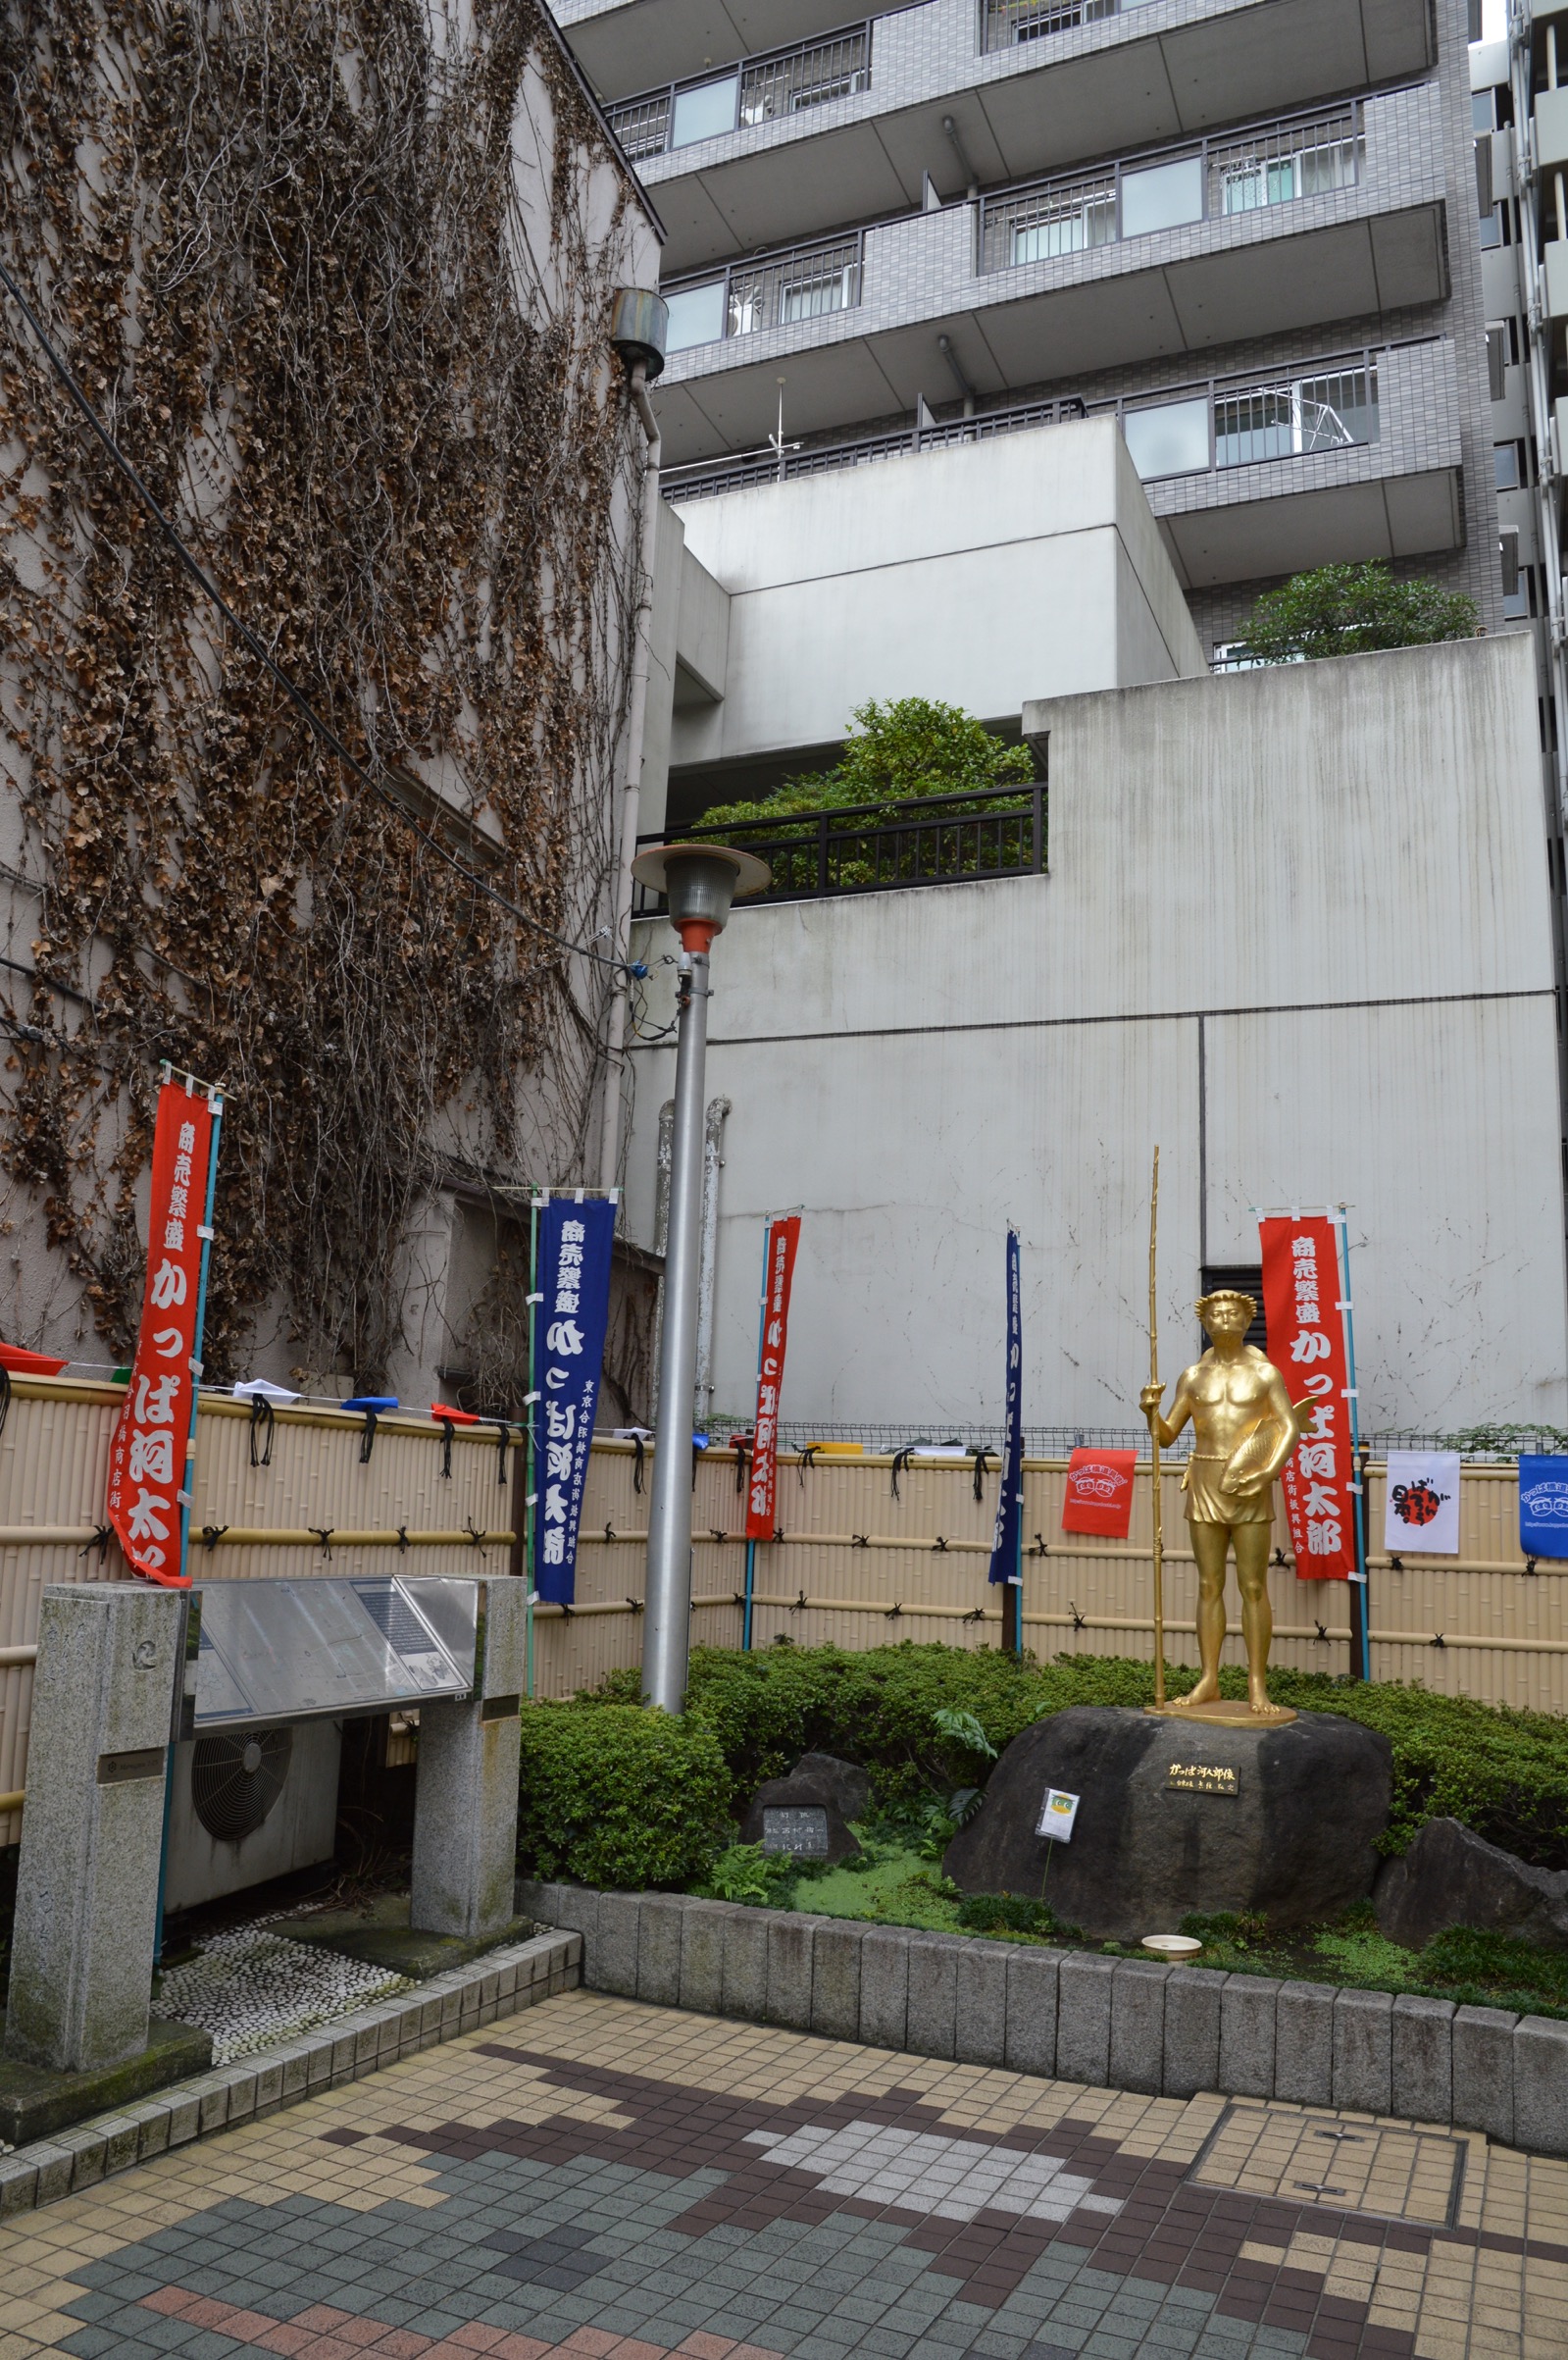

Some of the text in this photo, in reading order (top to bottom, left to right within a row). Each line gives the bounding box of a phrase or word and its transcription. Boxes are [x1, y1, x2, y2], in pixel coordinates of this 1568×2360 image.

[163, 1120, 195, 1253] 商売繁盛
[1291, 1235, 1321, 1324] 商売繁盛
[1520, 1482, 1568, 1503] かっぱ橋道
